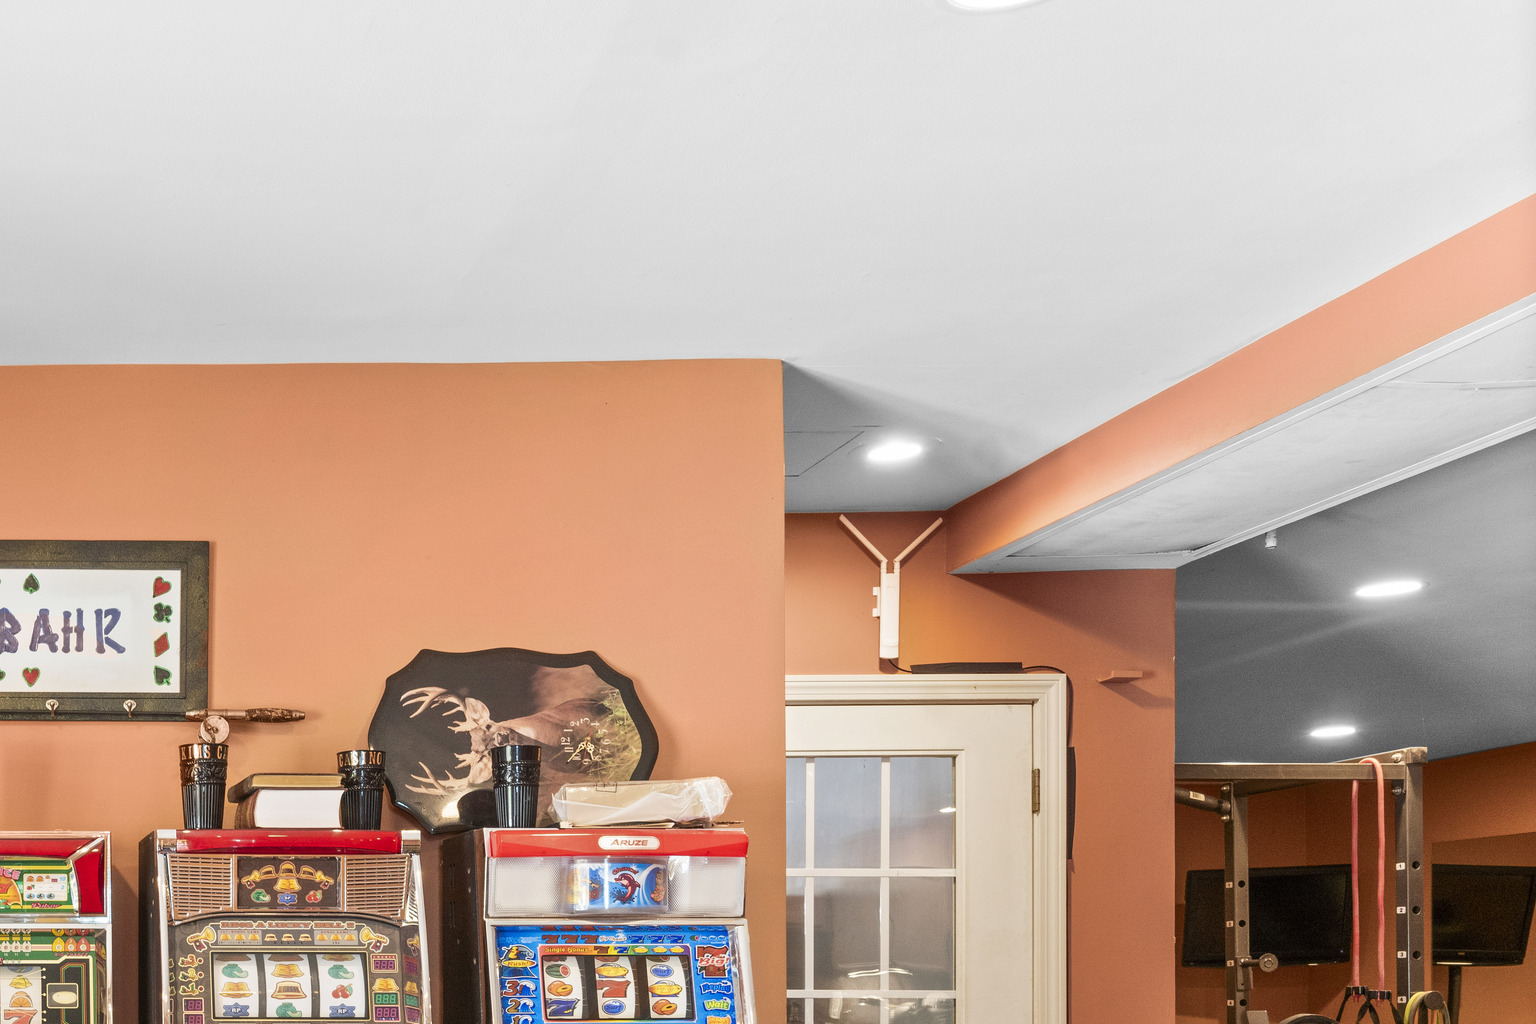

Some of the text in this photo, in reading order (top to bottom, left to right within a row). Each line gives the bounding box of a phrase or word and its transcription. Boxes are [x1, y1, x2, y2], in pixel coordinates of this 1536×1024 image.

[560, 736, 571, 745] 12
[181, 746, 211, 761] KIMS
[339, 751, 383, 768] CASINO
[611, 838, 649, 847] ARUZE
[698, 956, 730, 966] Big!
[703, 983, 731, 993] Replay
[507, 999, 520, 1013] 2
[705, 1000, 729, 1009] Wait
